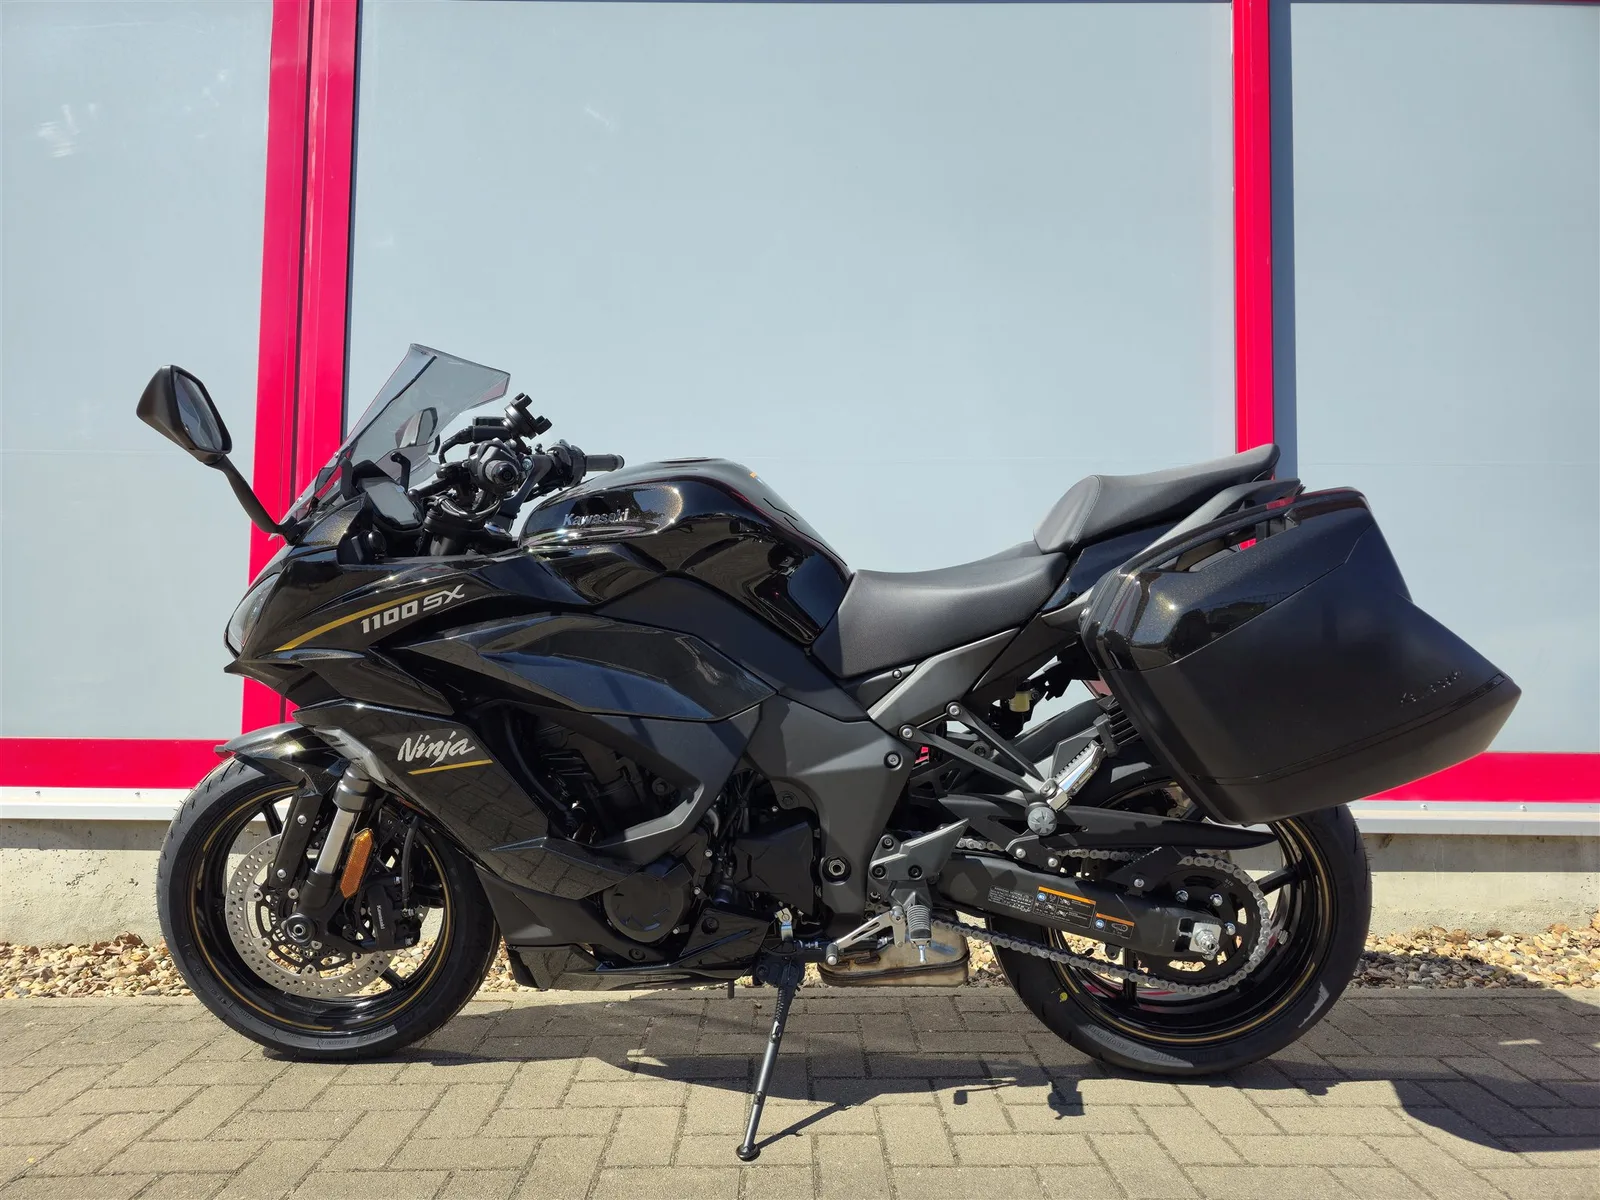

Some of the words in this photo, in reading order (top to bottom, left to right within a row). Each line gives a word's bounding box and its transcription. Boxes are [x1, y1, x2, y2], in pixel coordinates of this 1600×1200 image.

[562, 507, 630, 526] Kawasaki
[360, 600, 419, 634] 1100
[422, 583, 465, 612] SX
[397, 730, 476, 767] Ninja
